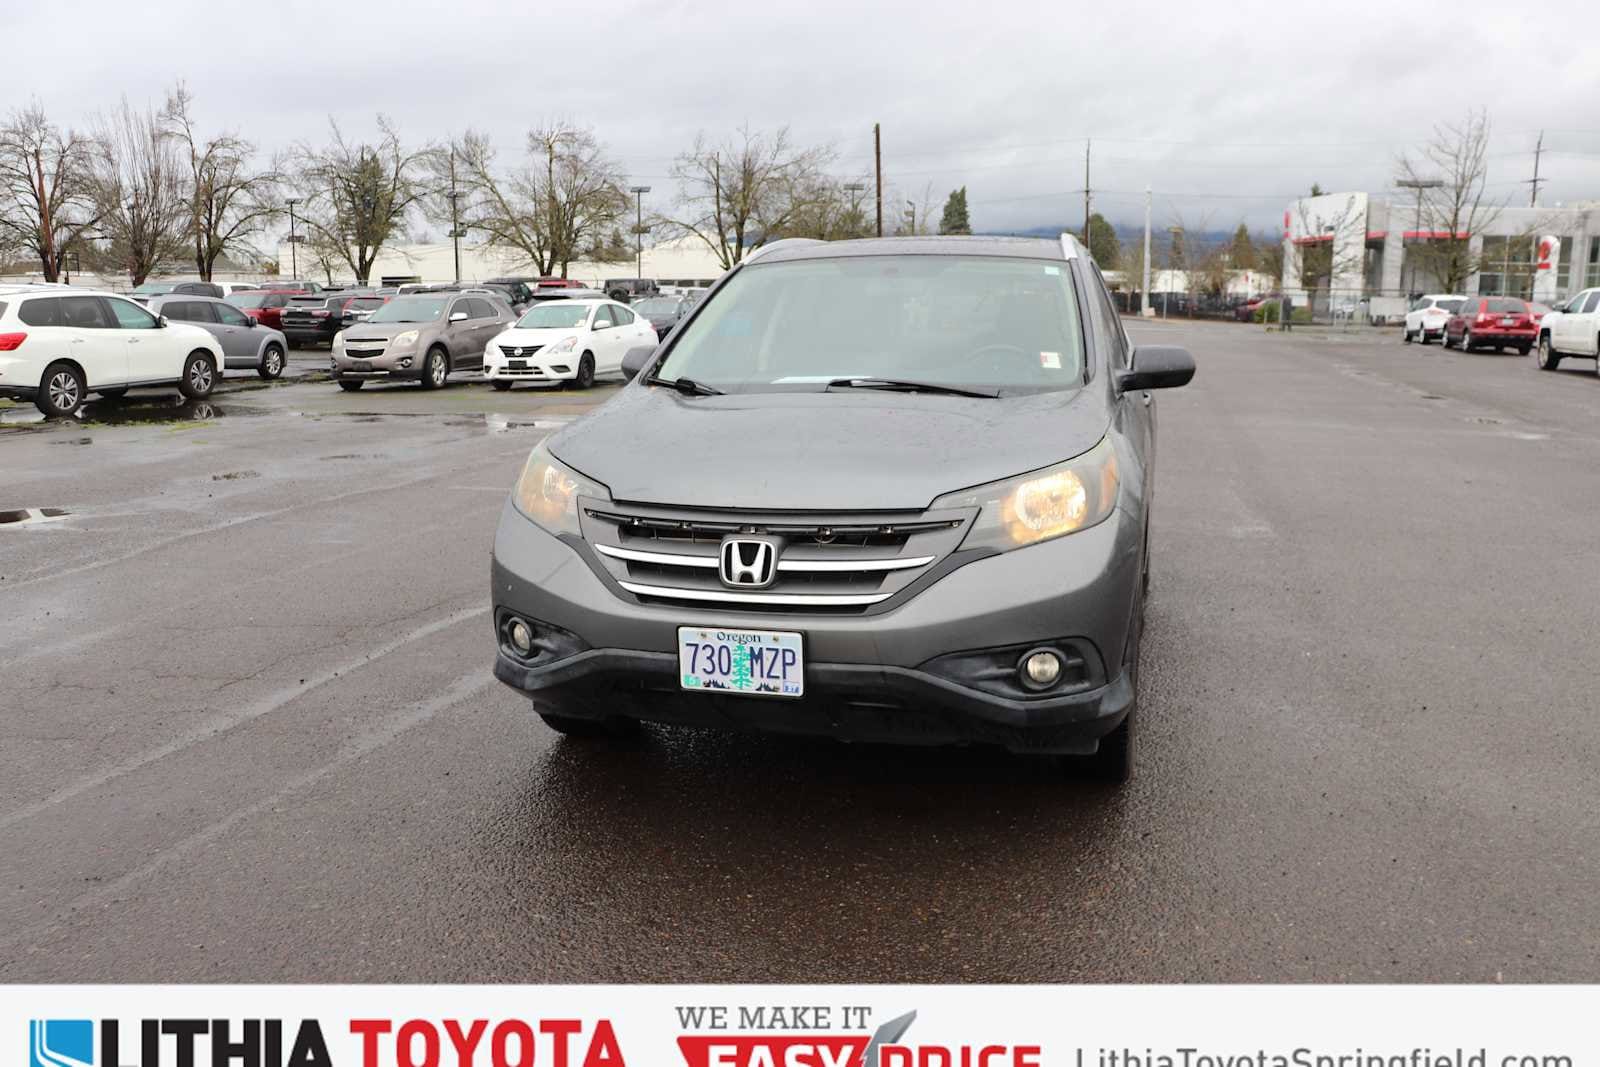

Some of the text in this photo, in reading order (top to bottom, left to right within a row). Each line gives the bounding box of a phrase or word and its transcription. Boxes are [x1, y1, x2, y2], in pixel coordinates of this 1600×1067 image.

[716, 631, 762, 645] Oregon
[685, 642, 797, 680] 730 MZP
